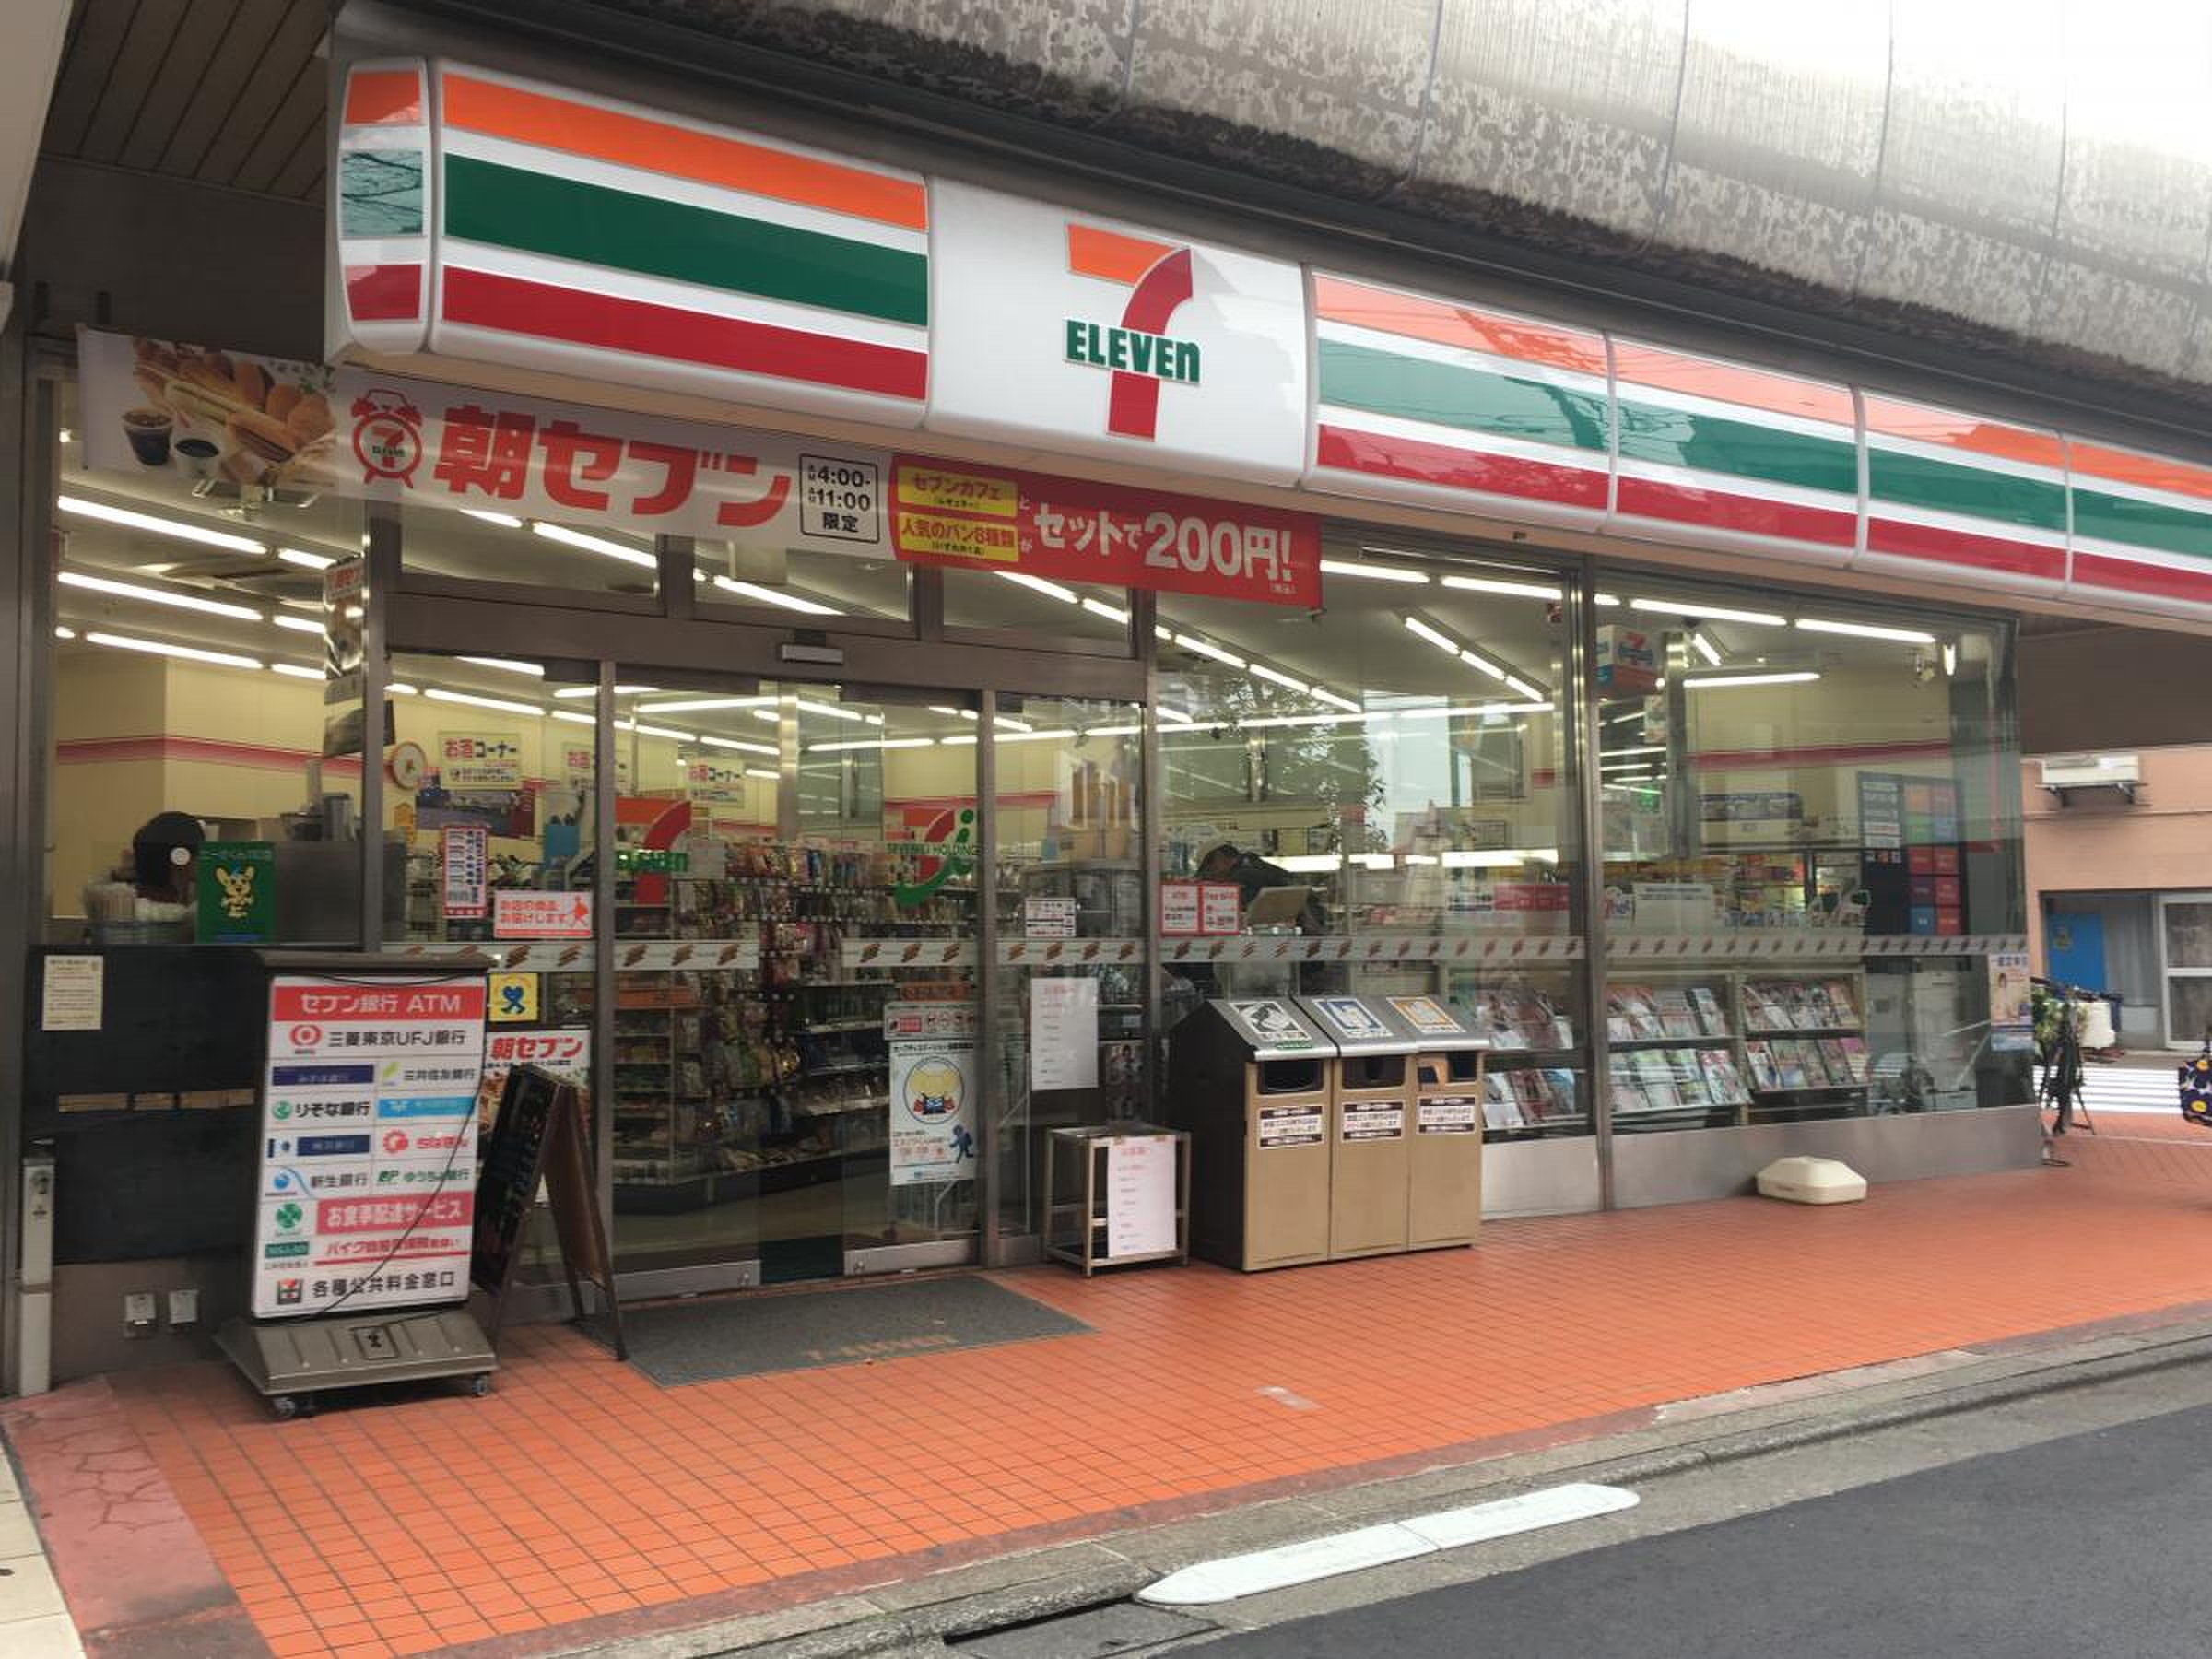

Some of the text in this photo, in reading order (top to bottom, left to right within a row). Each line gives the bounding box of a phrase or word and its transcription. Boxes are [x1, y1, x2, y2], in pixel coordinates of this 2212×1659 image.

[1066, 223, 1194, 441] 7
[433, 405, 792, 528] 朝セブン
[912, 474, 1002, 500] セブンカフェ
[817, 488, 871, 512] 11:00
[822, 512, 859, 533] 限定
[406, 995, 461, 1013] ATM
[328, 1030, 465, 1048] 三菱東京UFJ銀行
[490, 1035, 583, 1060] 朝セブン
[295, 1100, 370, 1121] りそな銀行
[312, 1271, 455, 1298] 各種公共料金窓口
